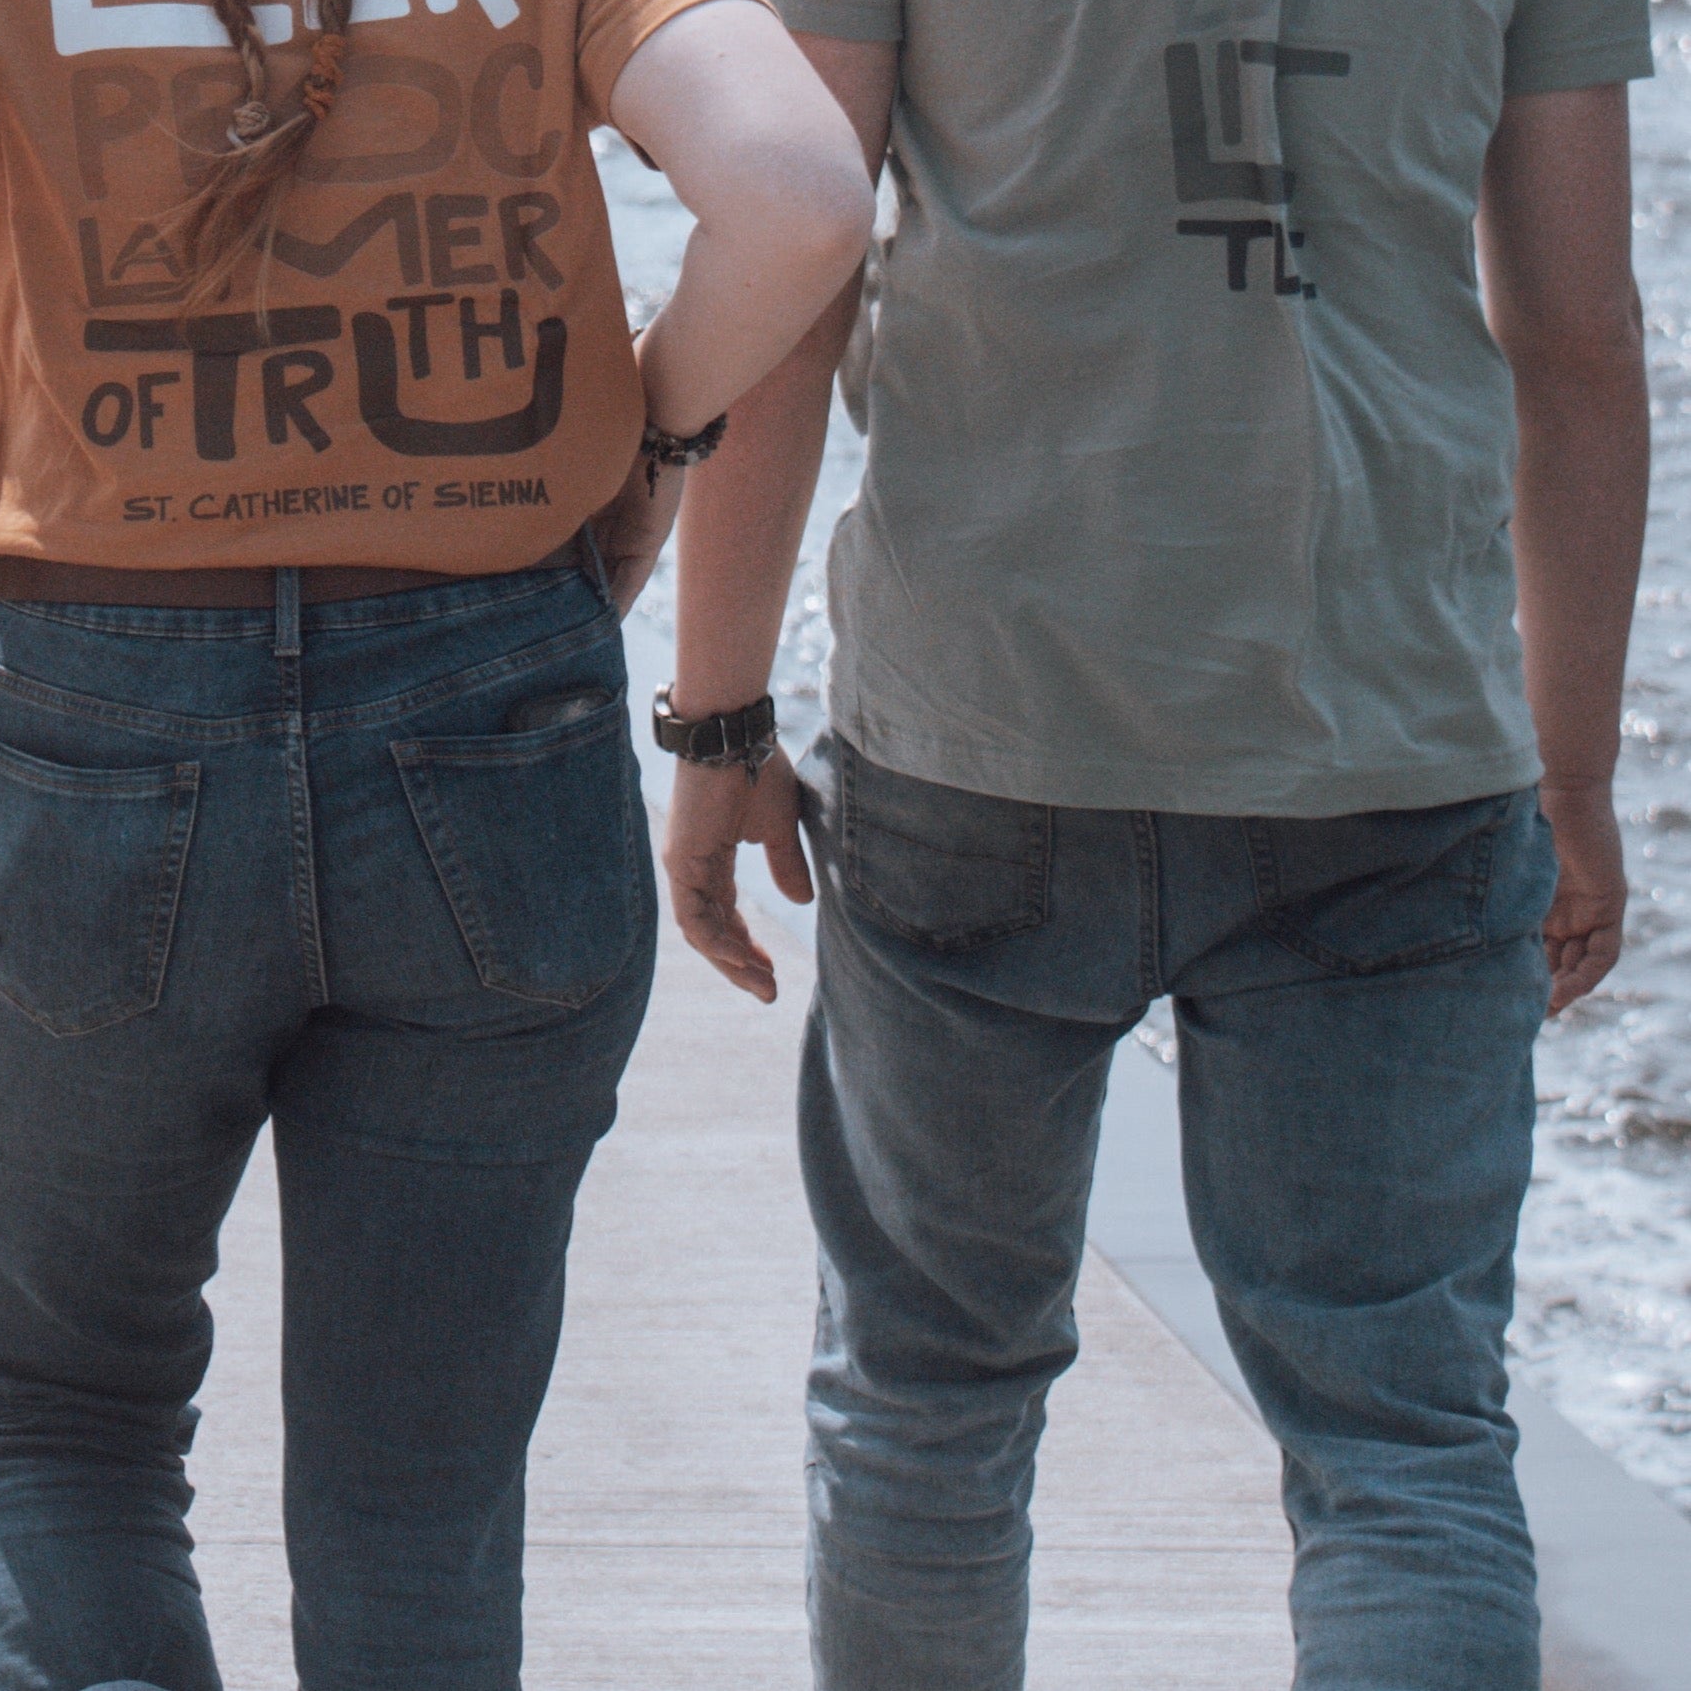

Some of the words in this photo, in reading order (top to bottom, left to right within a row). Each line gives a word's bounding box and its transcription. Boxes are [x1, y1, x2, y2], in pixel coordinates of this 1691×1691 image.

[78, 191, 565, 308] LAMER
[80, 371, 181, 449] OF
[122, 494, 177, 523] ST.
[188, 484, 369, 521] CATHERINE
[381, 481, 421, 510] OF
[433, 478, 552, 508] SIENNA
